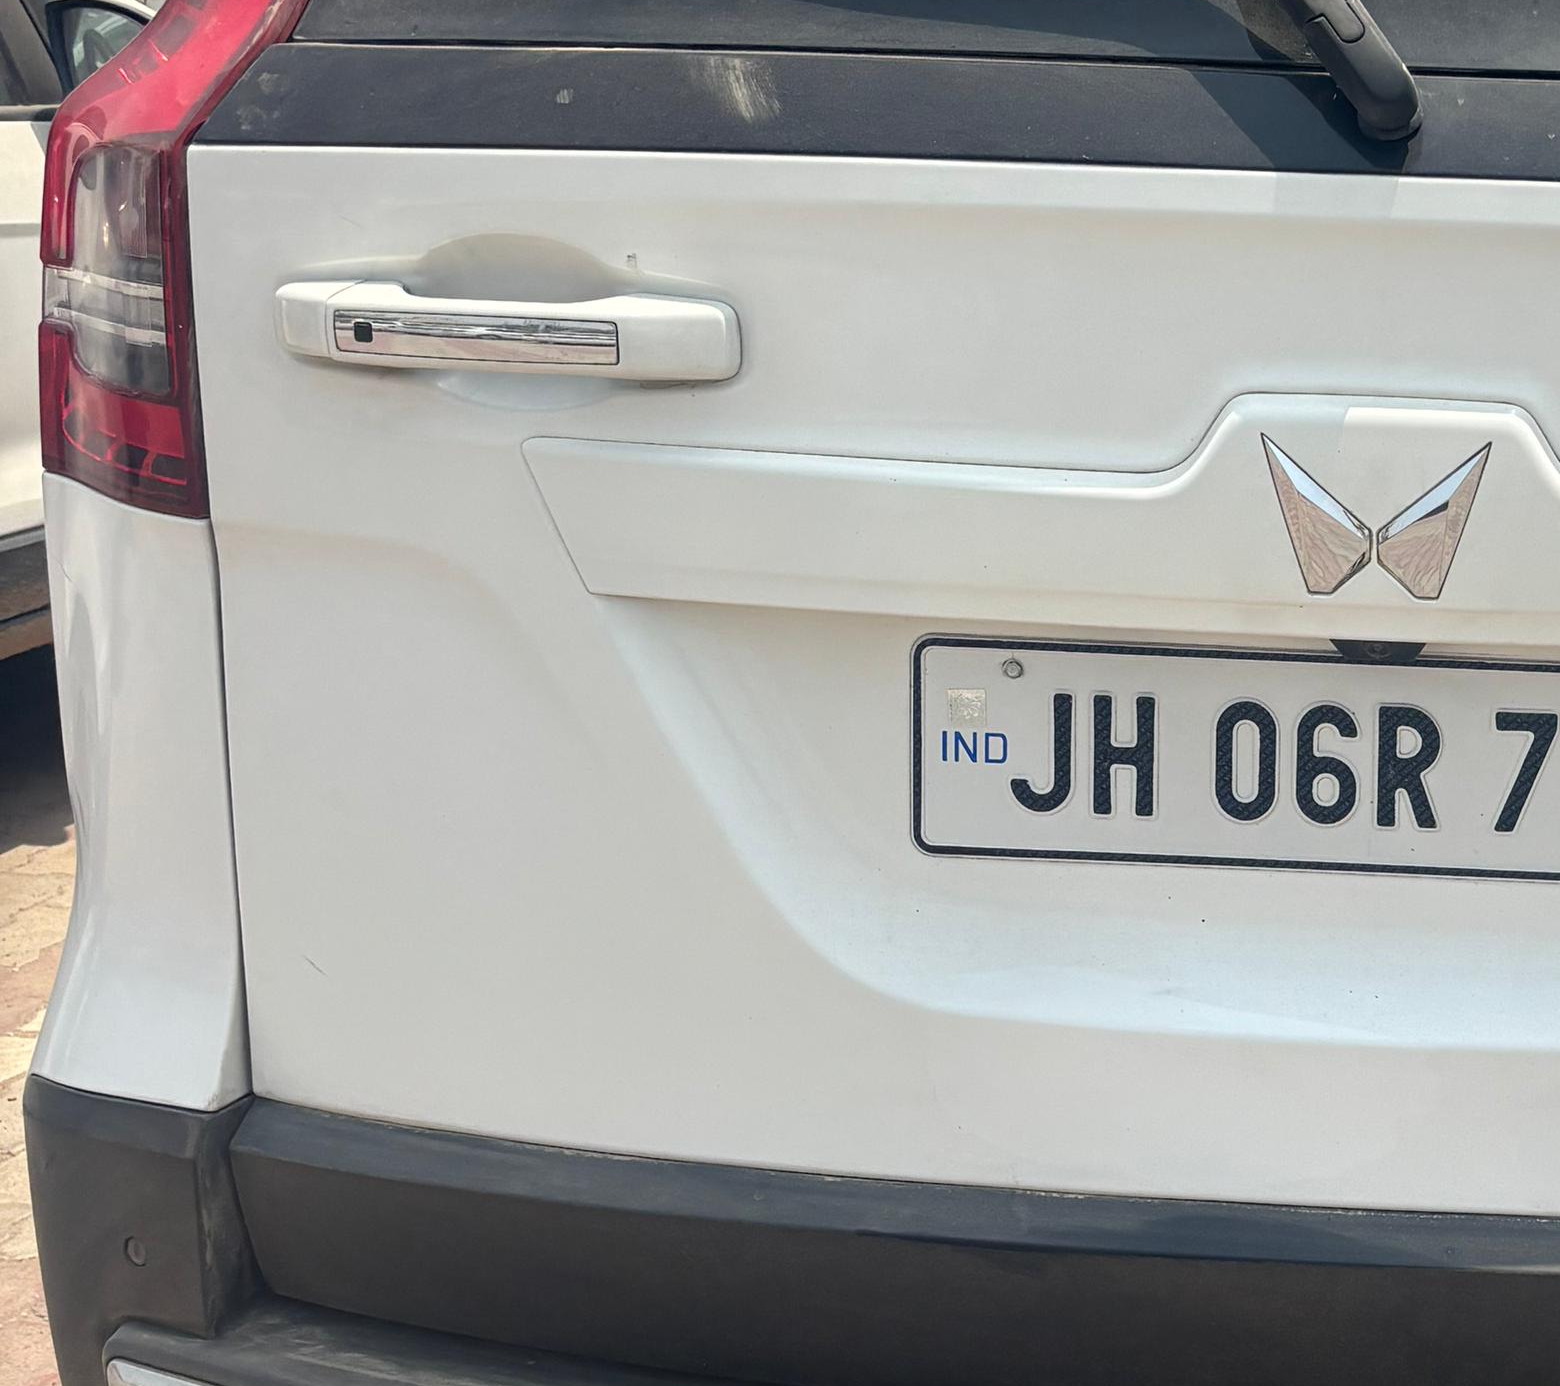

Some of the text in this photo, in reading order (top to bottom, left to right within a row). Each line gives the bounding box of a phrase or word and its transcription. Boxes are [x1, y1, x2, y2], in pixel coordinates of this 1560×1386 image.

[941, 730, 1008, 764] IND
[1010, 693, 1156, 817] JH
[1214, 700, 1441, 829] 06R
